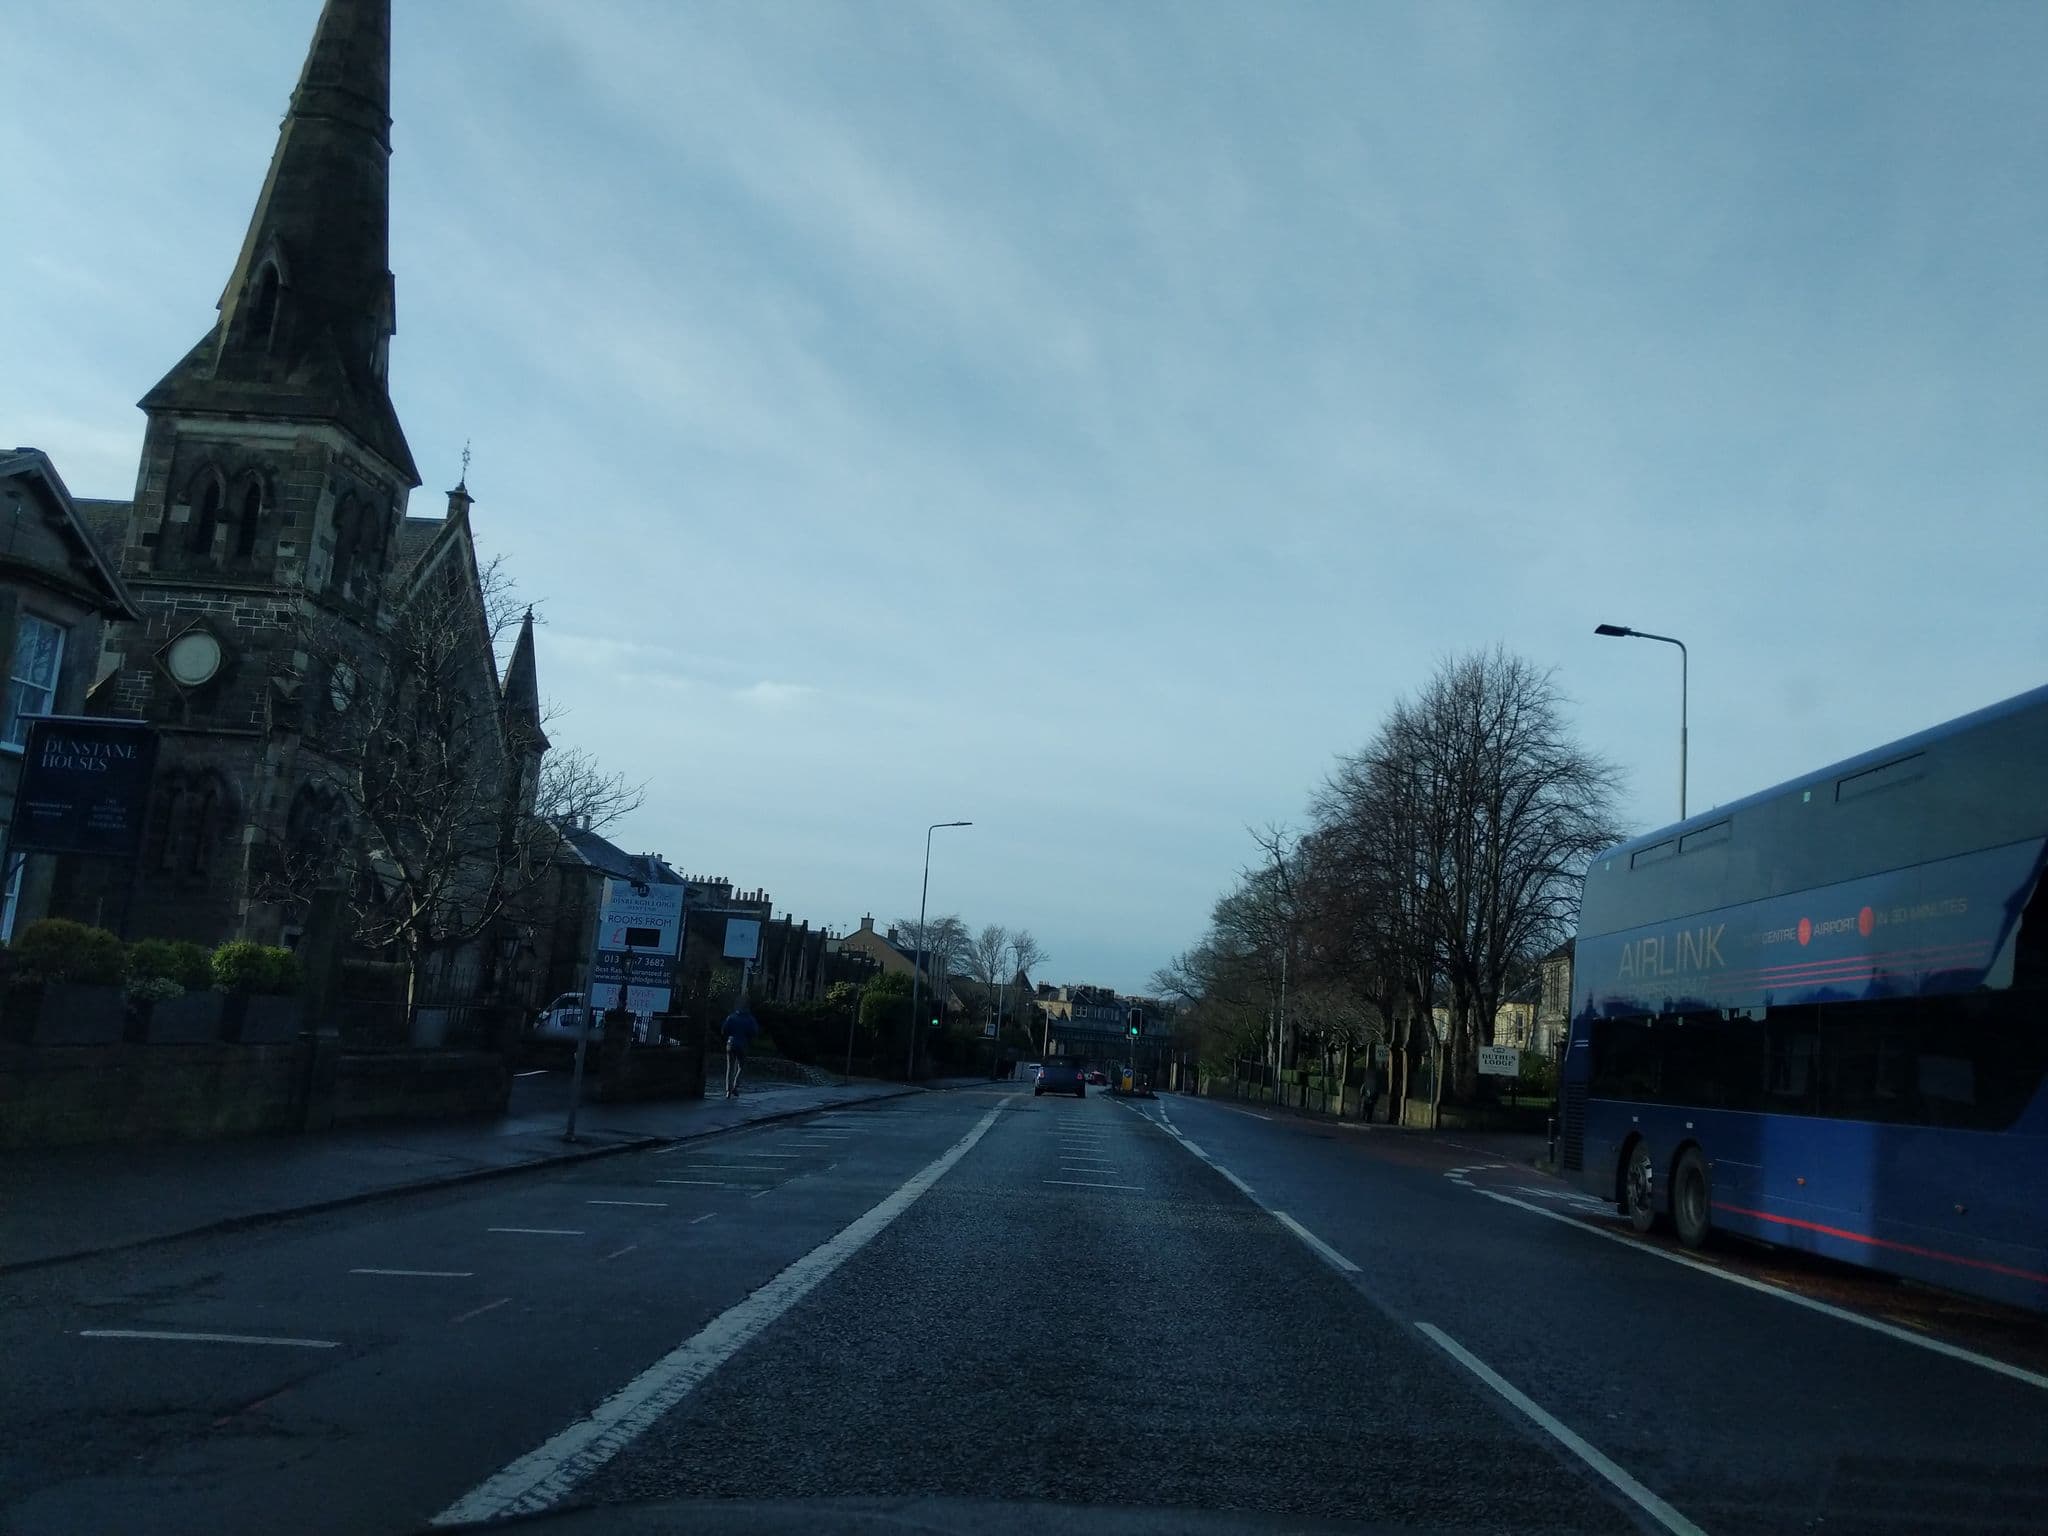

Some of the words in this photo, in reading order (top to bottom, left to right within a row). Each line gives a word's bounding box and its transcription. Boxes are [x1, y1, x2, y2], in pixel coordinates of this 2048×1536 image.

[44, 739, 137, 759] DUNSTANE
[41, 754, 107, 771] HOUSES
[608, 914, 642, 925] ROOMS
[645, 917, 672, 927] FROM
[1761, 927, 1796, 945] CENTRE
[1812, 917, 1856, 937] AIRPORT
[1617, 922, 1727, 977] AIRLINK
[644, 957, 665, 967] 3682
[1484, 1059, 1513, 1067] LODGE
